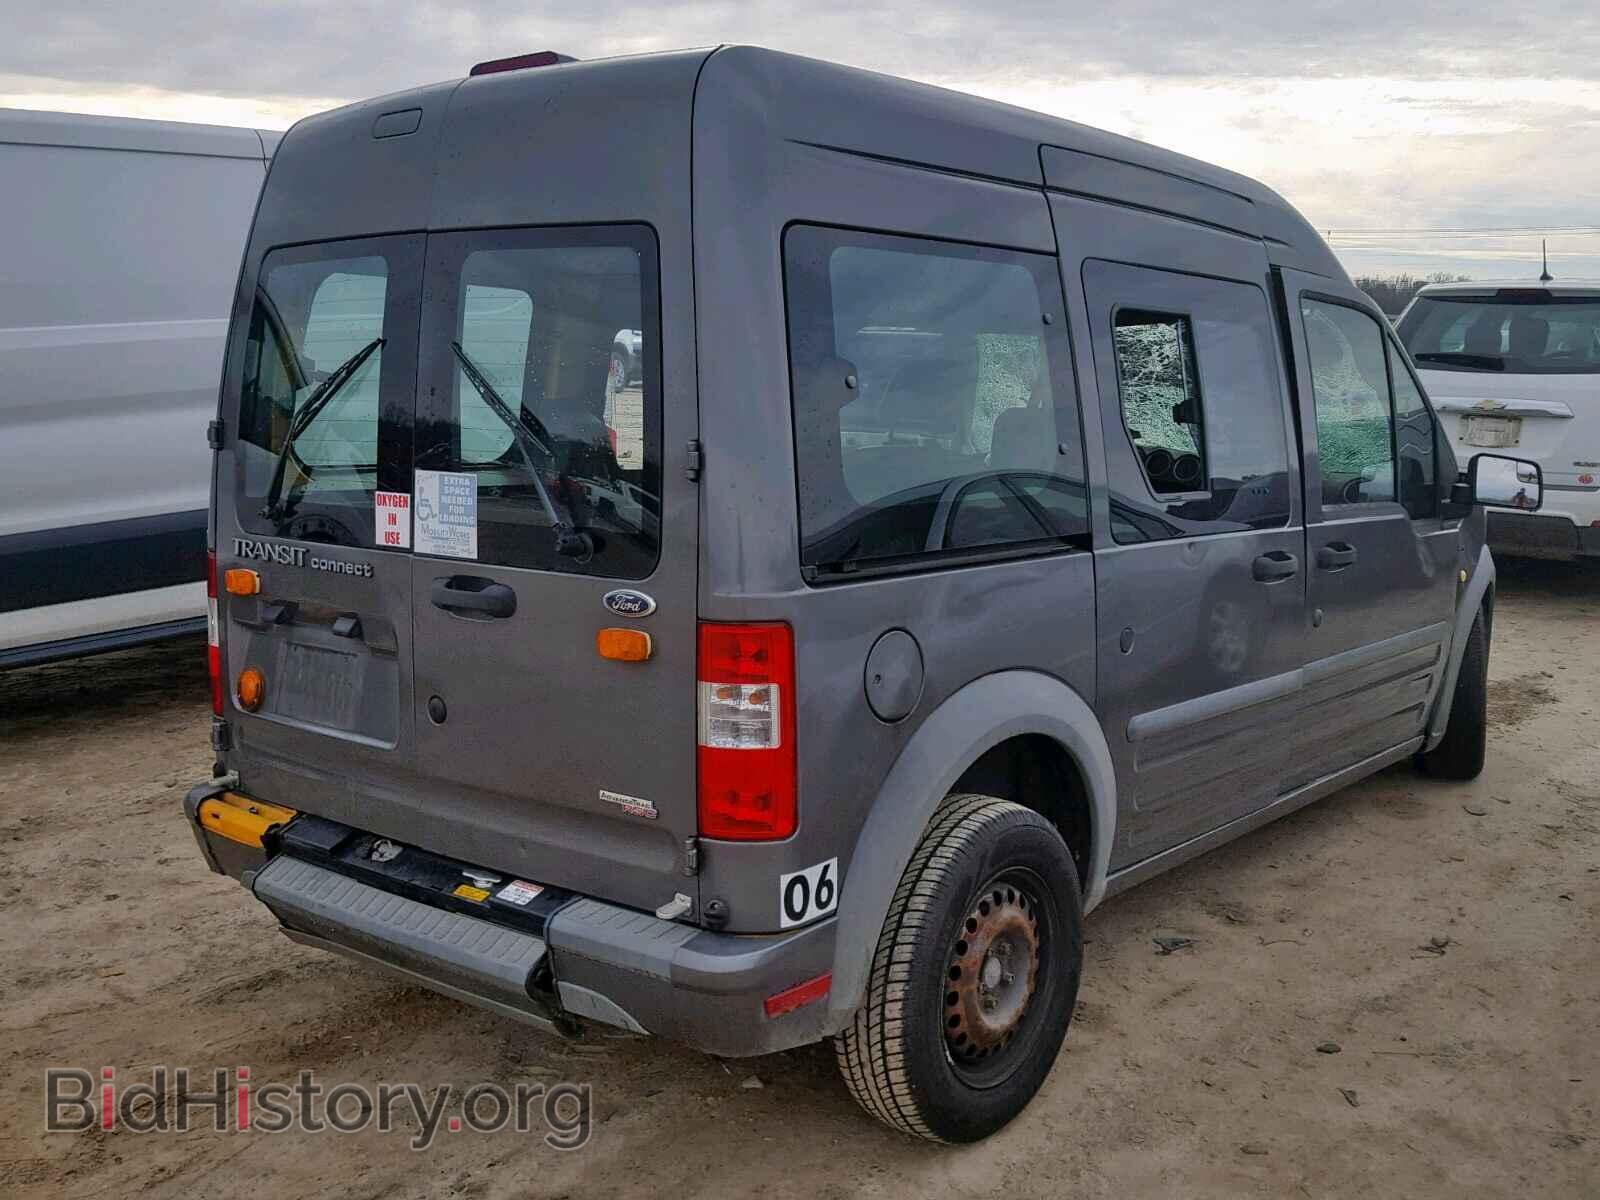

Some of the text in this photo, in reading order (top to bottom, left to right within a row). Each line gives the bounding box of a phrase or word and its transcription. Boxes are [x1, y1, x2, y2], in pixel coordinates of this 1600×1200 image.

[444, 476, 471, 487] EXTRA
[443, 487, 471, 497] SPACE
[376, 494, 409, 509] OXYGEN
[388, 512, 397, 526] IN
[384, 531, 401, 545] USE
[232, 538, 374, 578] TRANSIT connect
[612, 594, 643, 611] Ford
[784, 863, 834, 922] 06
